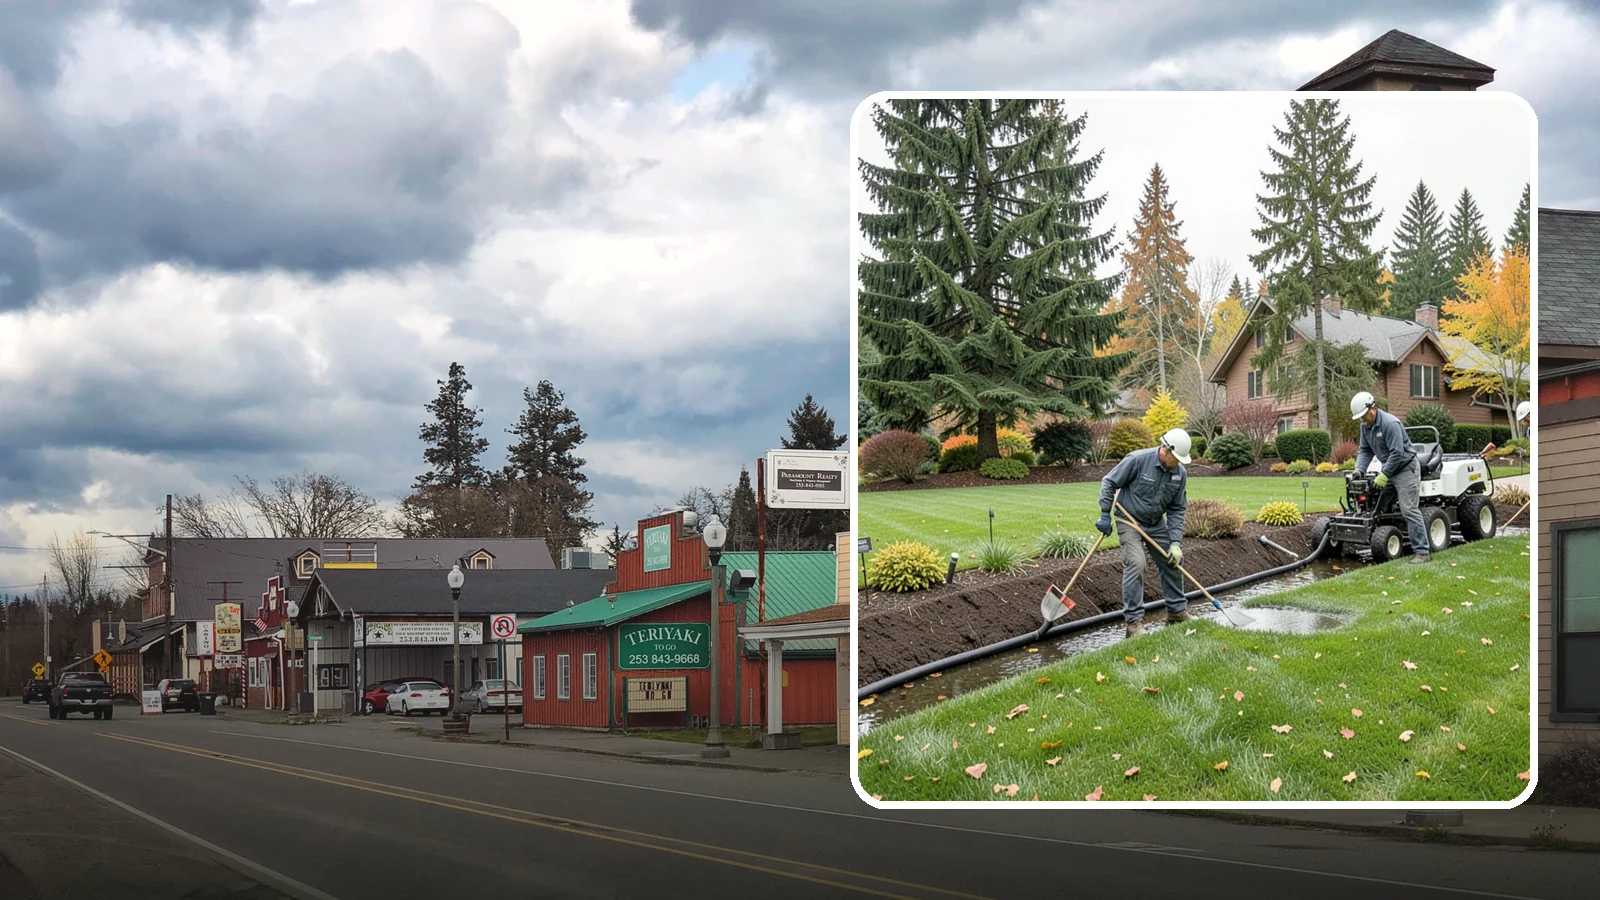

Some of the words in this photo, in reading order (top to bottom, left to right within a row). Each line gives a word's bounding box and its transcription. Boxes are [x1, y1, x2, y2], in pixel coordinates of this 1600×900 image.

[781, 471, 814, 479] PARAMOUNT
[625, 627, 702, 646] TERIYAKI
[629, 655, 648, 664] 253
[652, 654, 700, 664] 843-9668
